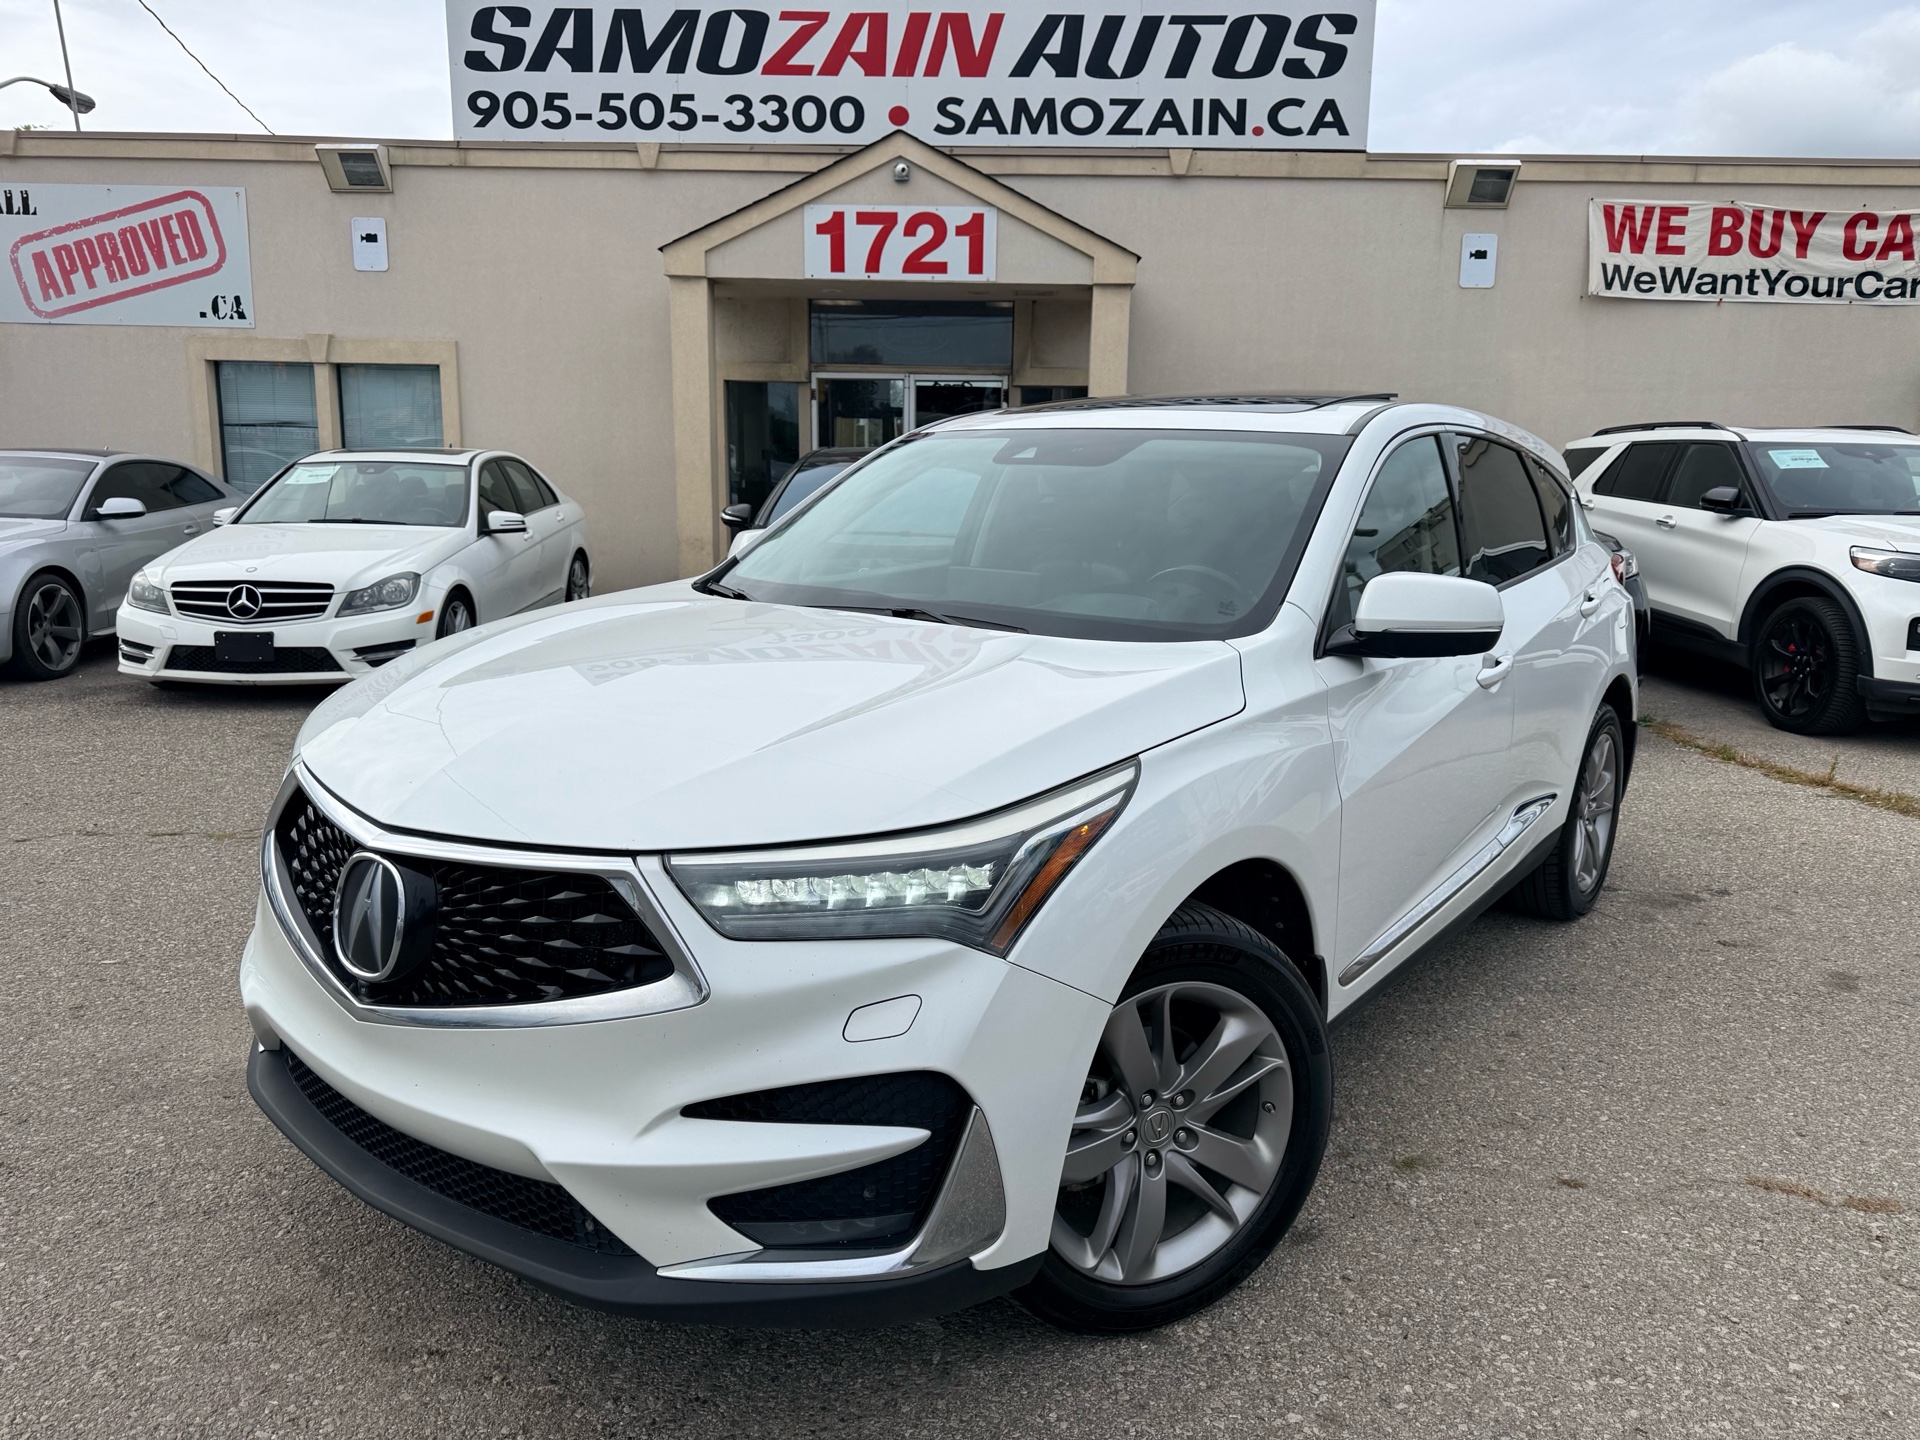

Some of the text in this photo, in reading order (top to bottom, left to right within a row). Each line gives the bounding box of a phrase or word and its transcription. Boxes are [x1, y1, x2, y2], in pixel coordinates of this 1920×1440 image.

[464, 6, 1358, 79] SAMOZAIN AUTOS
[467, 90, 1350, 137] 905-505-3300 SAMOZAIN.CA
[0, 189, 37, 215] LL
[31, 209, 208, 302] APPROVED
[816, 211, 985, 275] 1721
[1602, 204, 1690, 256] WE
[1707, 206, 1828, 260] BUY
[1600, 262, 1920, 300] WeWantYourCar
[199, 294, 248, 320] .CA
